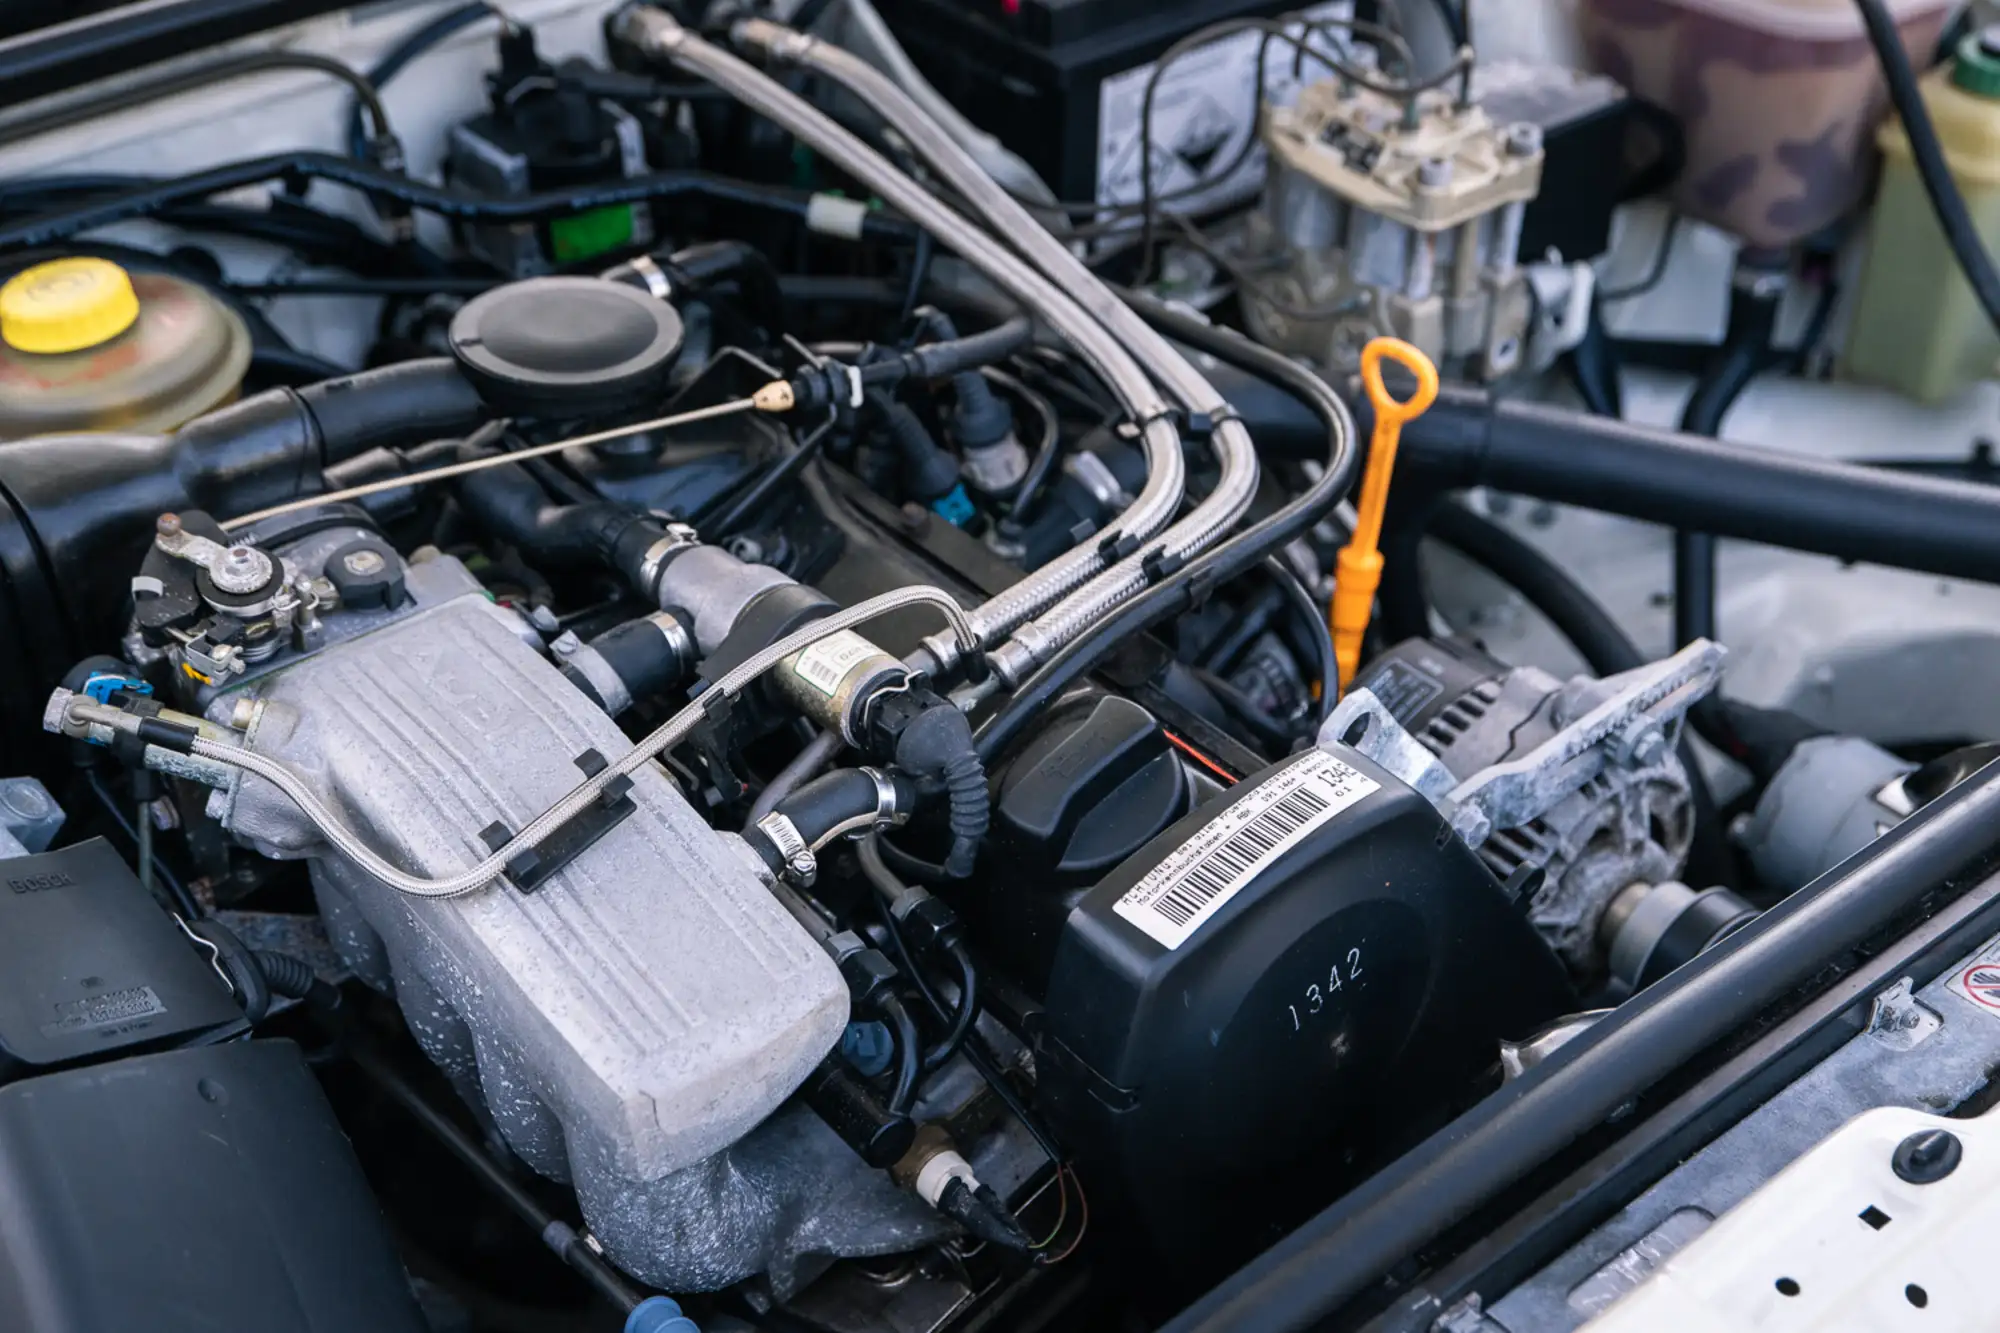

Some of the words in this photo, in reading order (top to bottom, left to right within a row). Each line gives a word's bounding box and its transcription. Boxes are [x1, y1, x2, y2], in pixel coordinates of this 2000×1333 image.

[6, 872, 76, 894] BOSCH
[1136, 832, 1224, 906] Motorkennbuchstaben
[1288, 947, 1363, 1031] 1342
